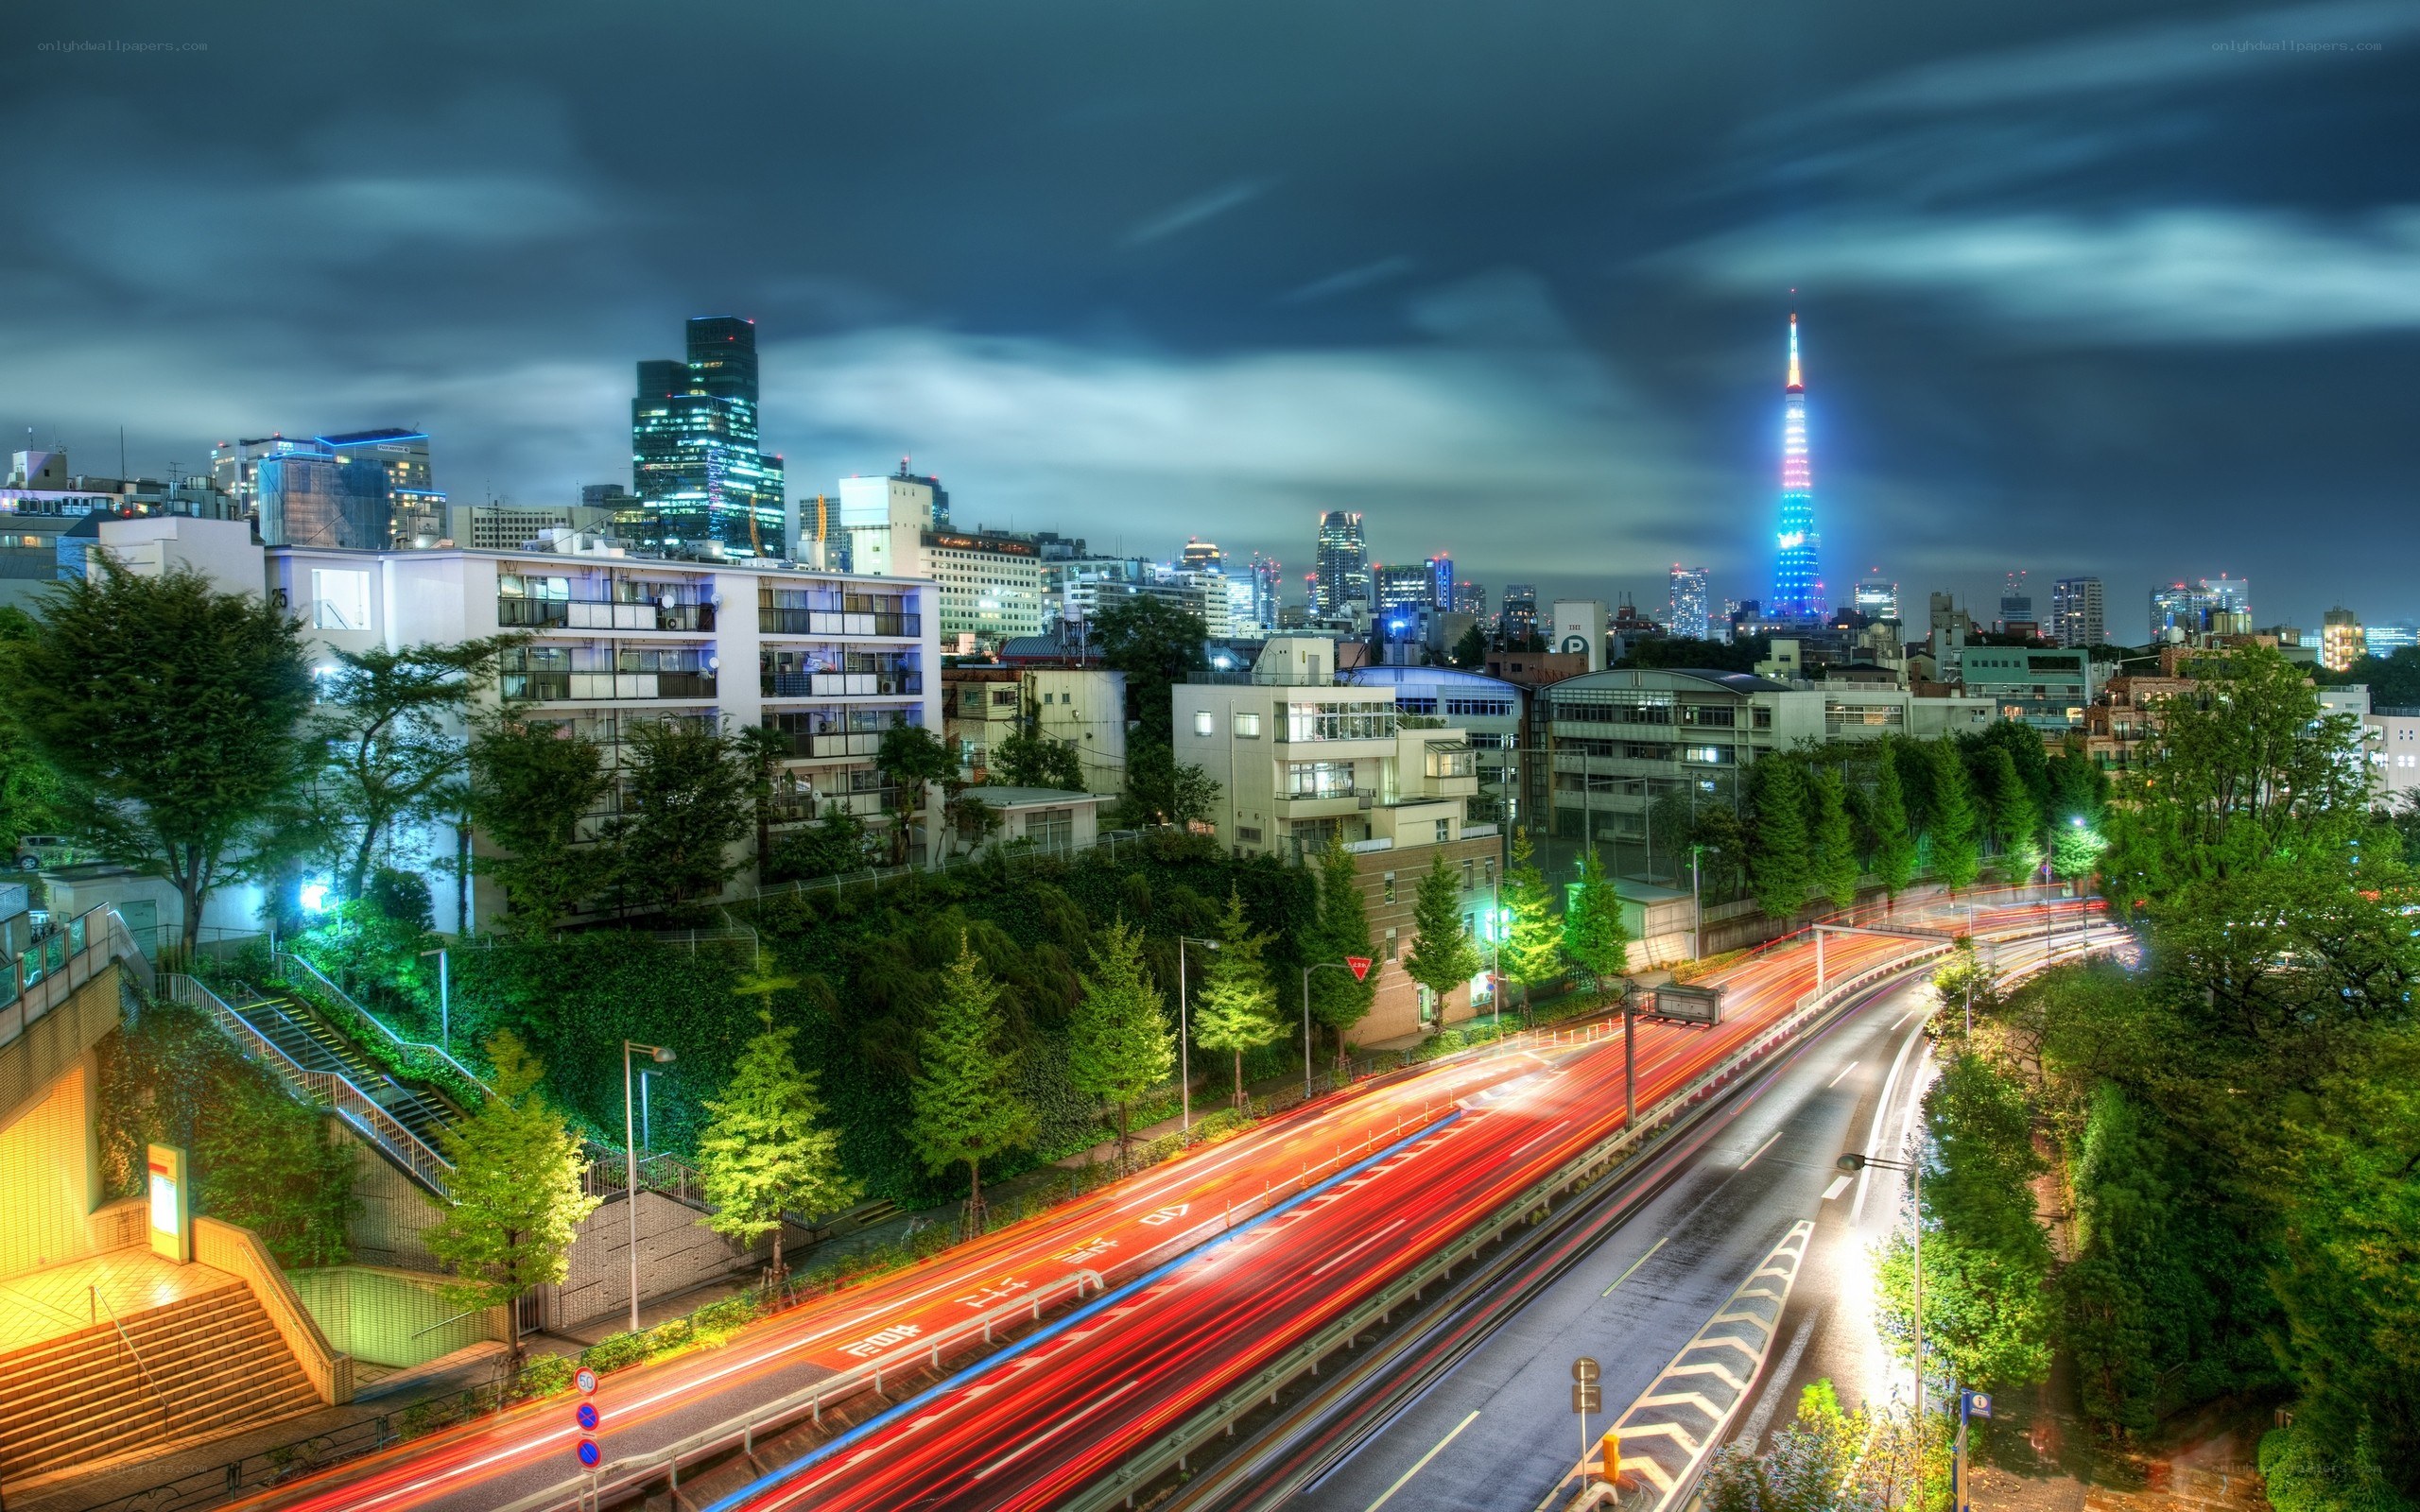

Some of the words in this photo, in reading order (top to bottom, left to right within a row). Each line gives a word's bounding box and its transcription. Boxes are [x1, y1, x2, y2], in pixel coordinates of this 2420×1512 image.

[271, 588, 287, 609] 25
[1568, 639, 1583, 653] P
[579, 1374, 594, 1389] 50
